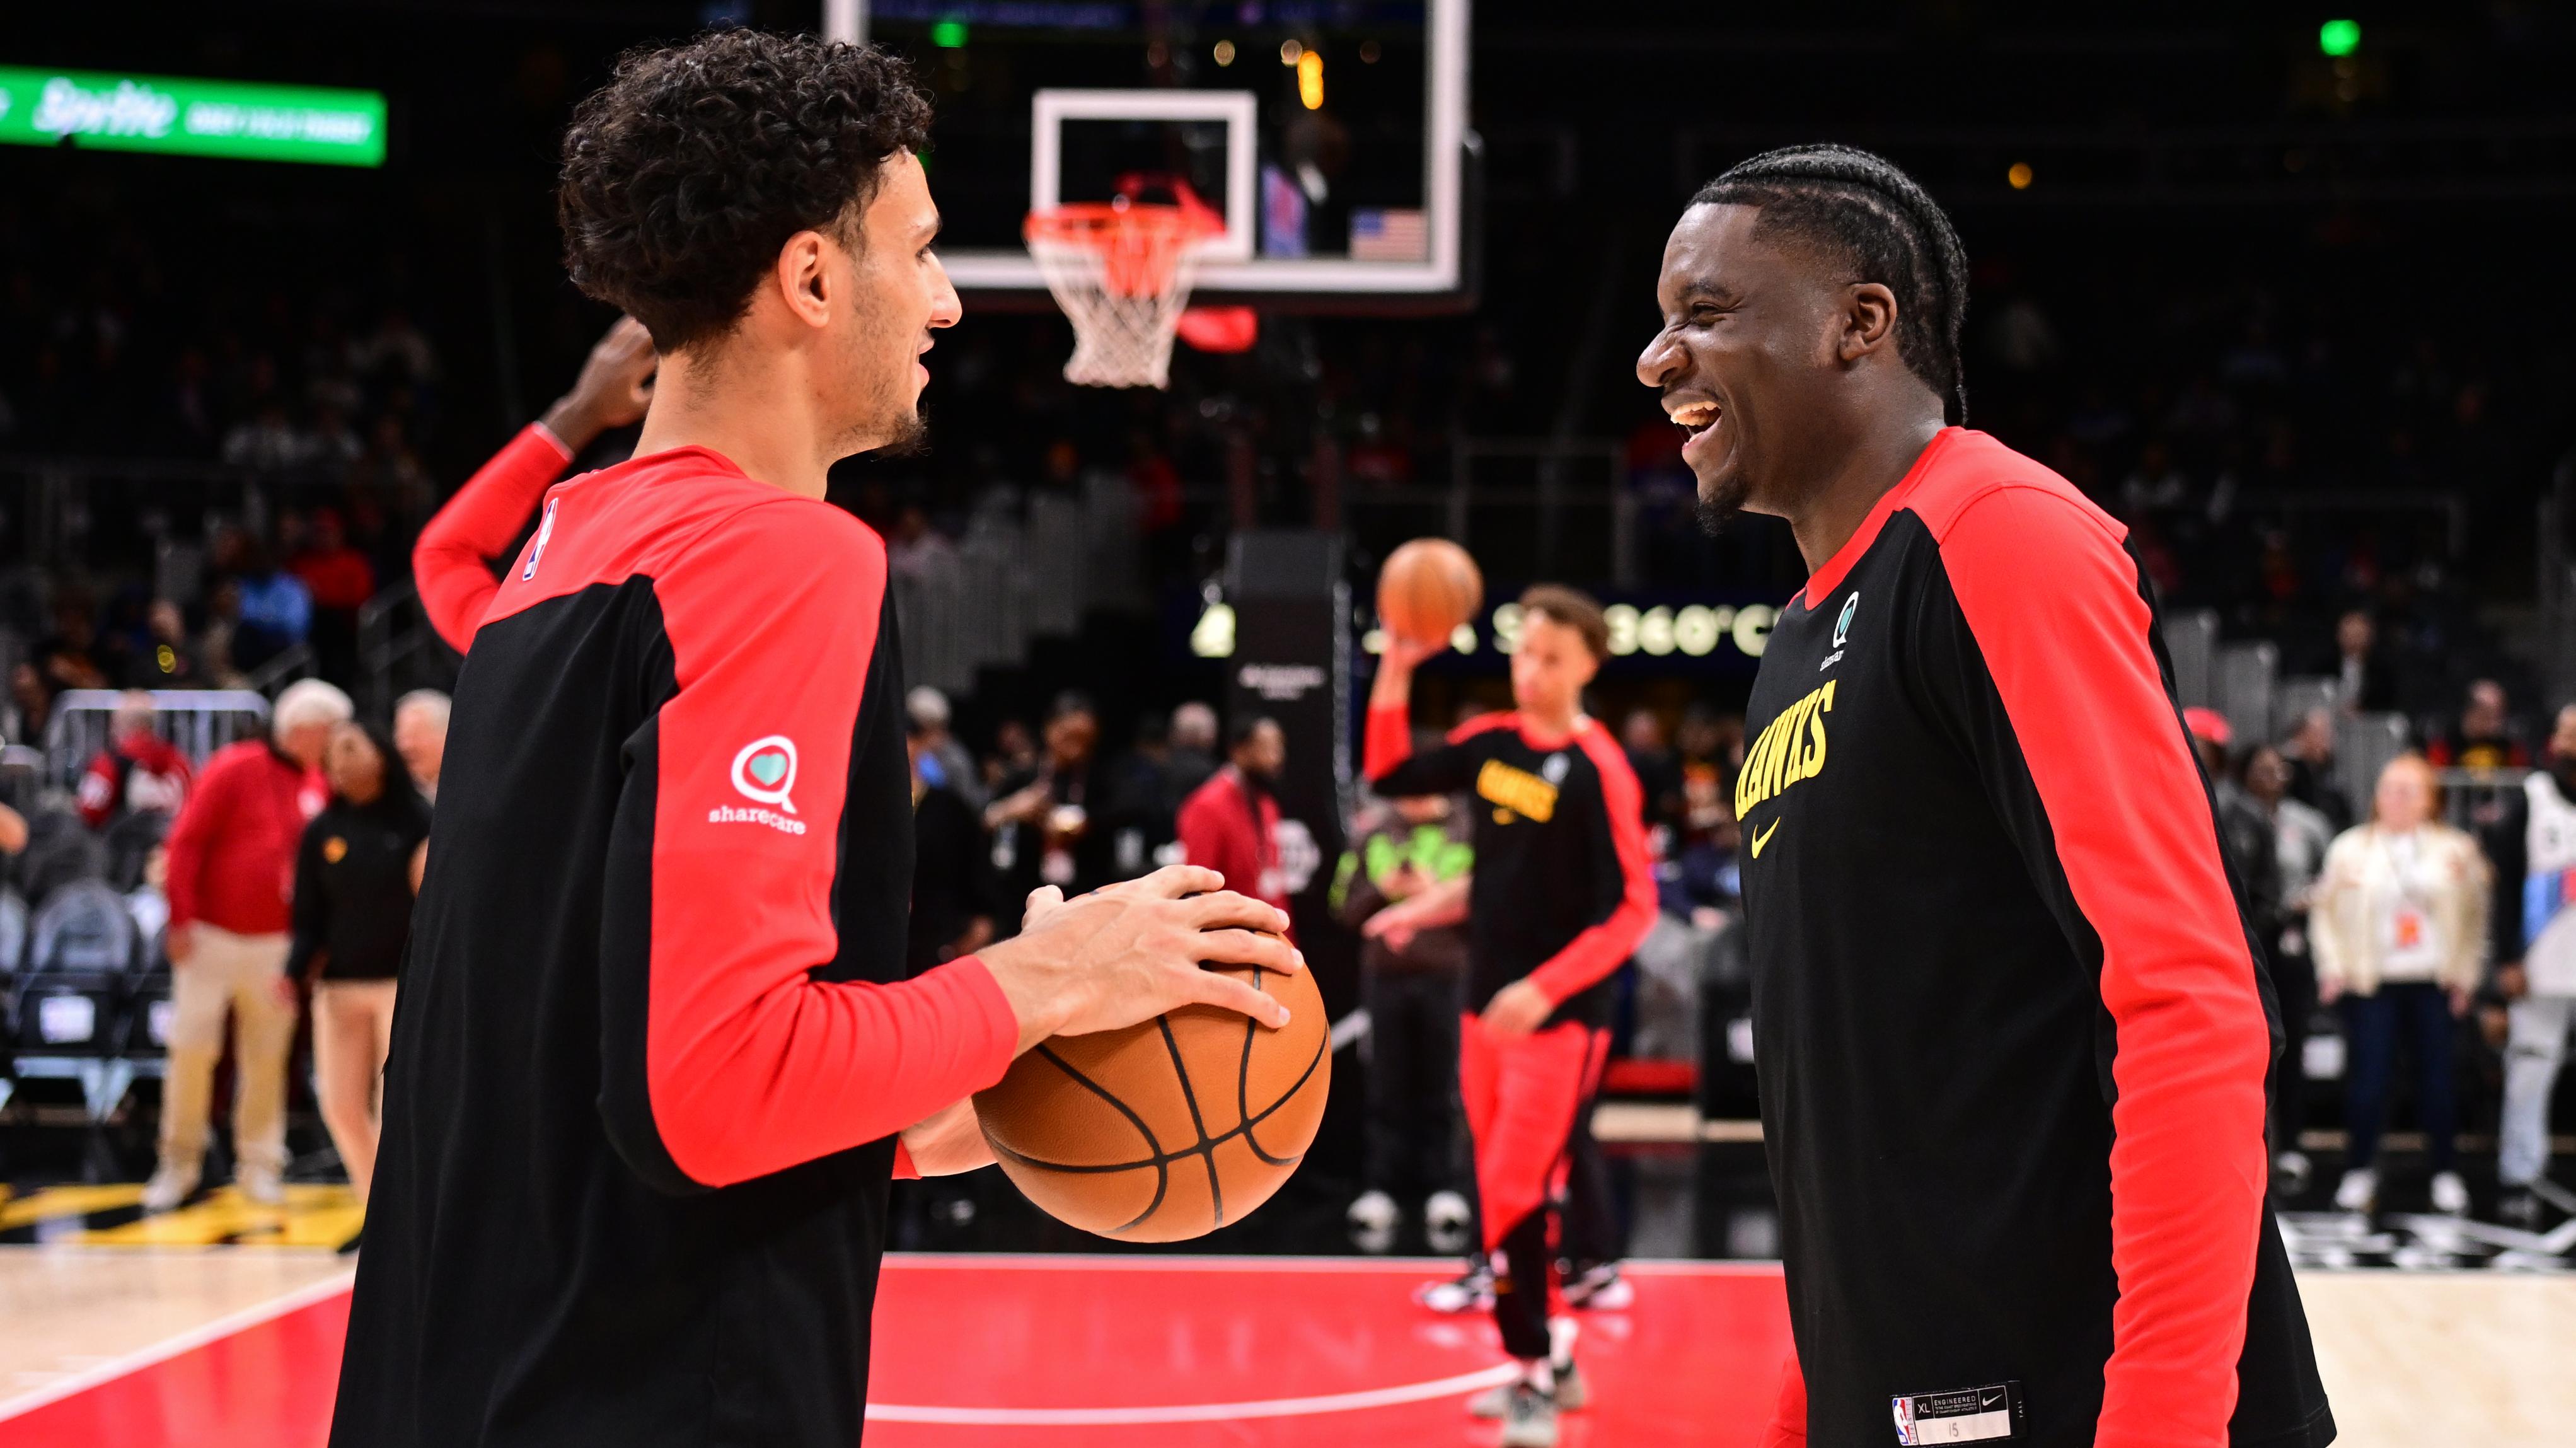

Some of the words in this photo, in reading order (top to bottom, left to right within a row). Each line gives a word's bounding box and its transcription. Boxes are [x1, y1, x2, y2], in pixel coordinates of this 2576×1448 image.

[33, 76, 177, 137] Sprite
[708, 805, 806, 835] sharecare
[1934, 1396, 1976, 1406] ENGINEERED
[1917, 1403, 1931, 1414] XL
[1948, 1423, 1959, 1437] 15
